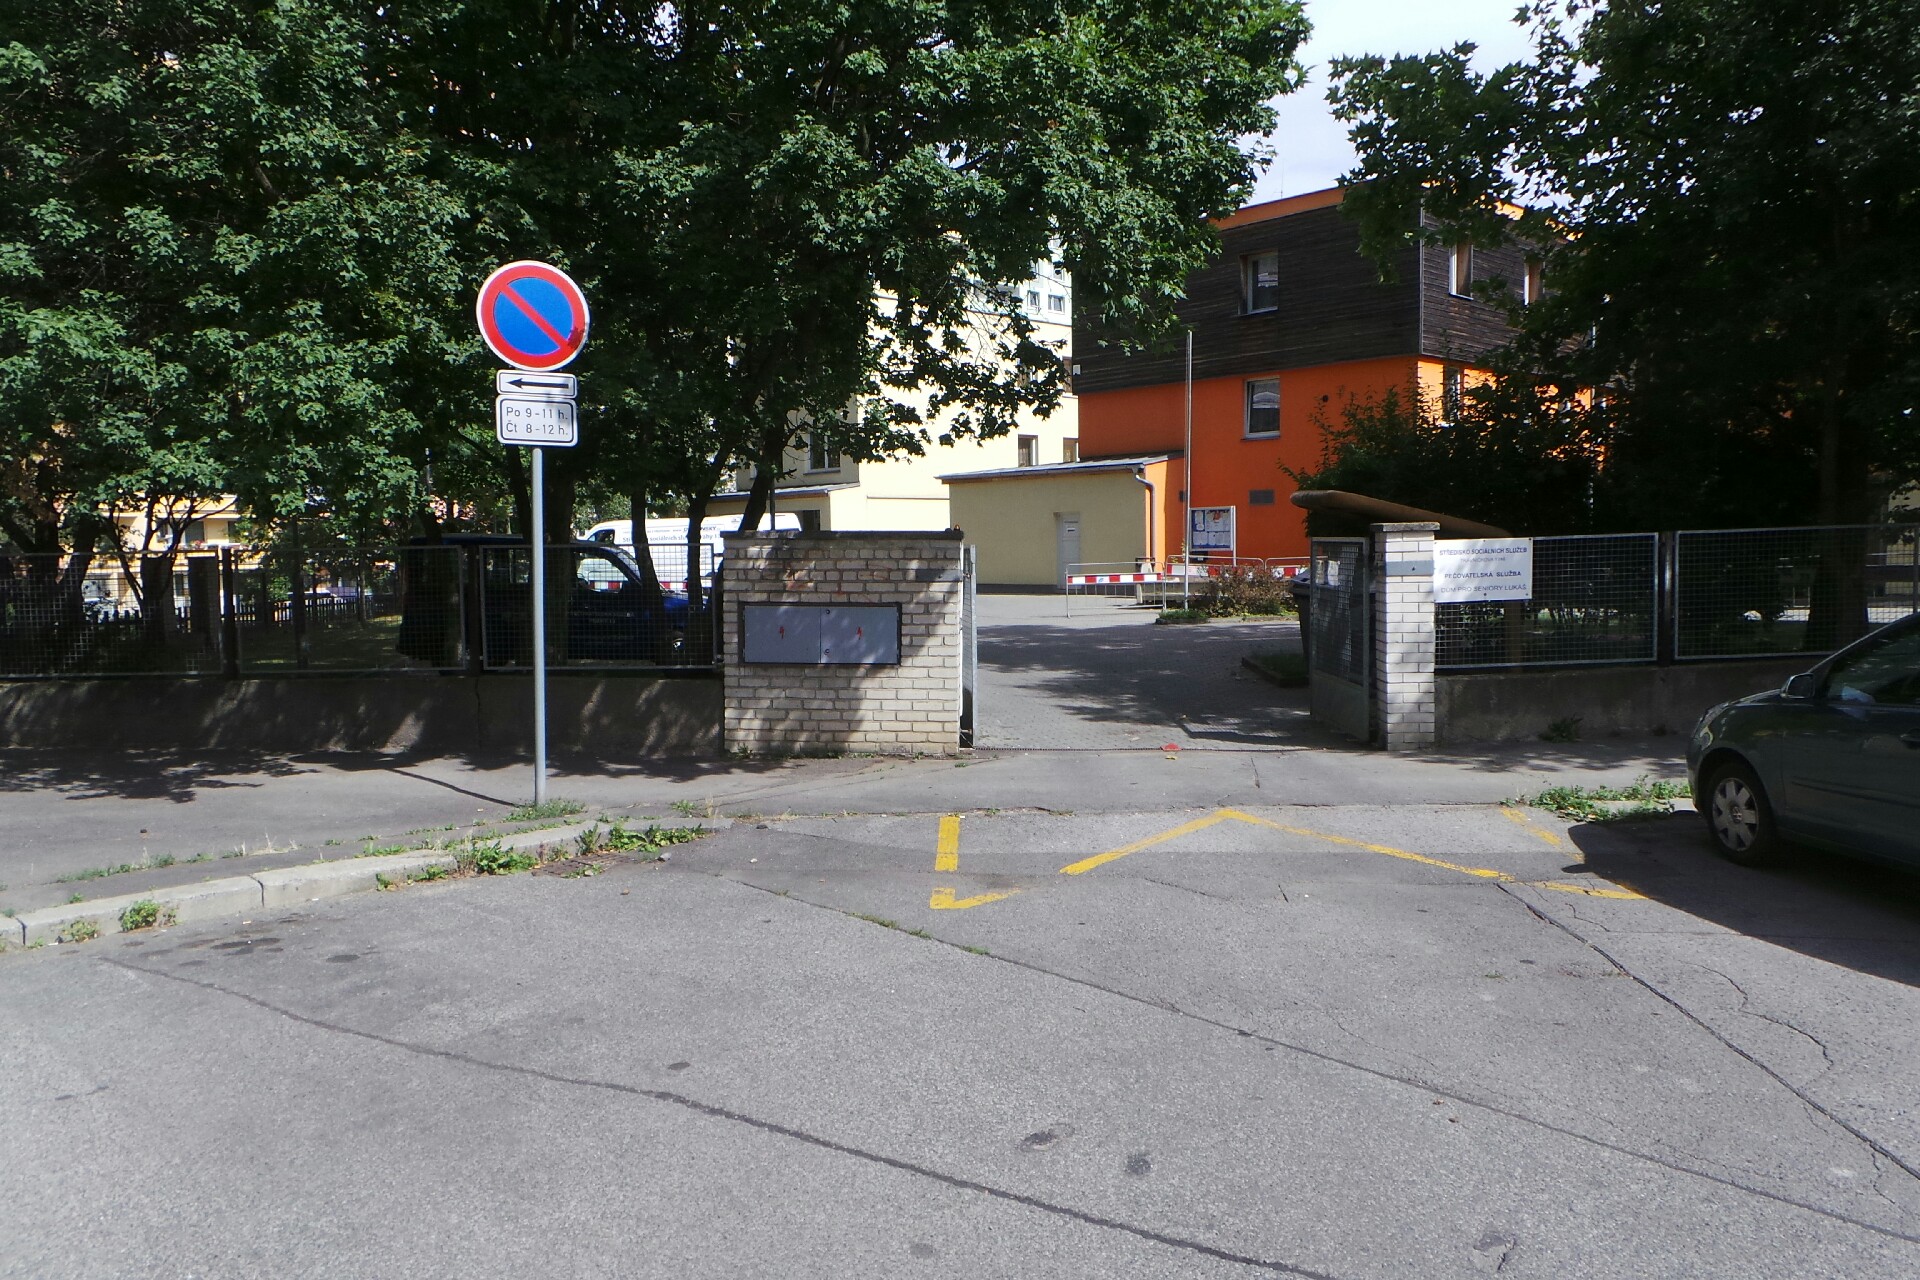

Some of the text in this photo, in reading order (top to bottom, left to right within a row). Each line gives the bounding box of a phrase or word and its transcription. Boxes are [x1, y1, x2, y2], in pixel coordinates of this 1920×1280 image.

[506, 407, 521, 416] Po
[558, 409, 568, 420] h.
[506, 419, 517, 432] Čt
[558, 425, 568, 435] h.
